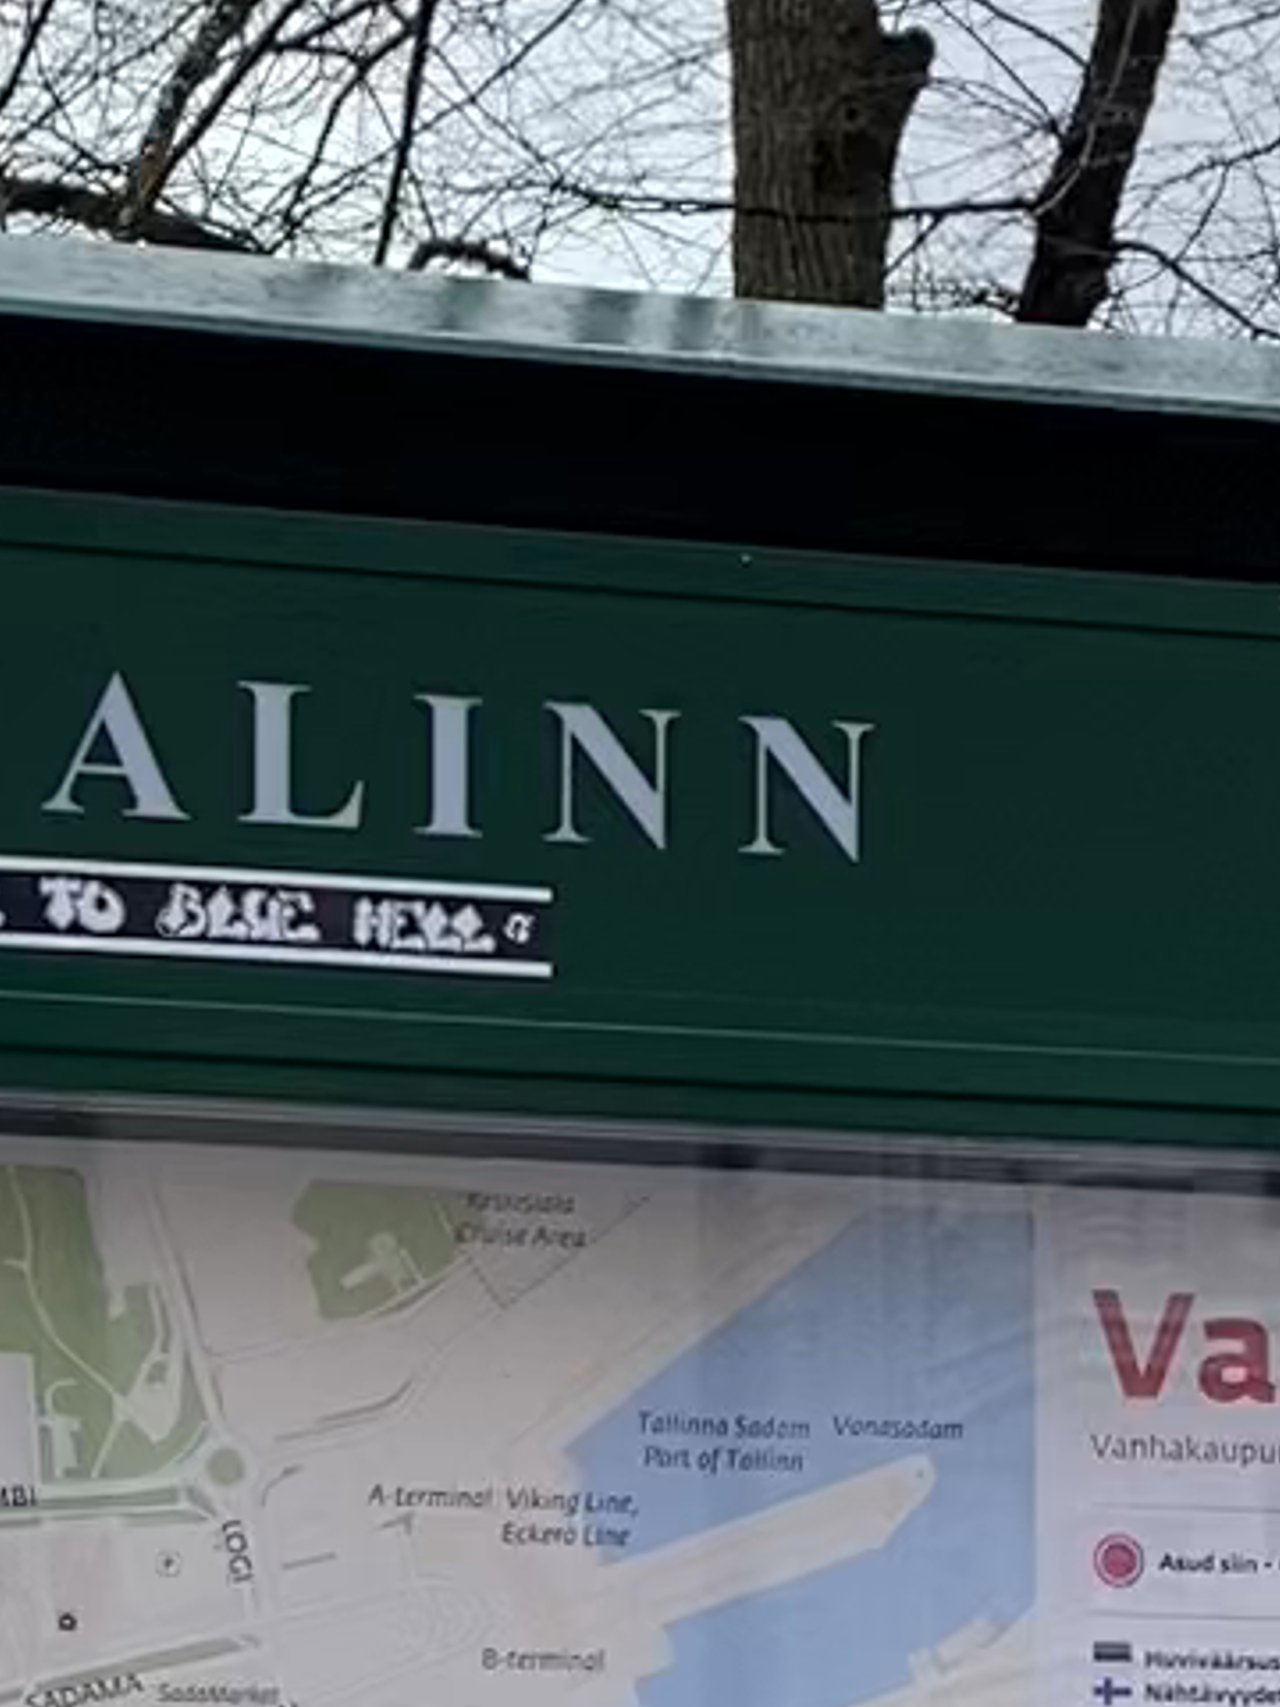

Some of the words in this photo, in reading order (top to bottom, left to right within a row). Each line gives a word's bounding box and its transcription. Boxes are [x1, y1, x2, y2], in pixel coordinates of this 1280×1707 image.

[39, 876, 124, 933] TO
[156, 882, 319, 940] BLUE
[354, 897, 495, 952] HELL
[640, 1410, 729, 1438] Tallinna
[734, 1412, 811, 1439] Sadam
[832, 1415, 964, 1440] Vanasadam
[643, 1445, 692, 1471] Port
[697, 1447, 721, 1475] of
[727, 1449, 804, 1473] Tallinn
[505, 1489, 579, 1517] Viking
[221, 1518, 253, 1581] LOGI
[1159, 1552, 1214, 1574] Asud
[1219, 1553, 1258, 1574] siin
[482, 1648, 606, 1672] B-terminal
